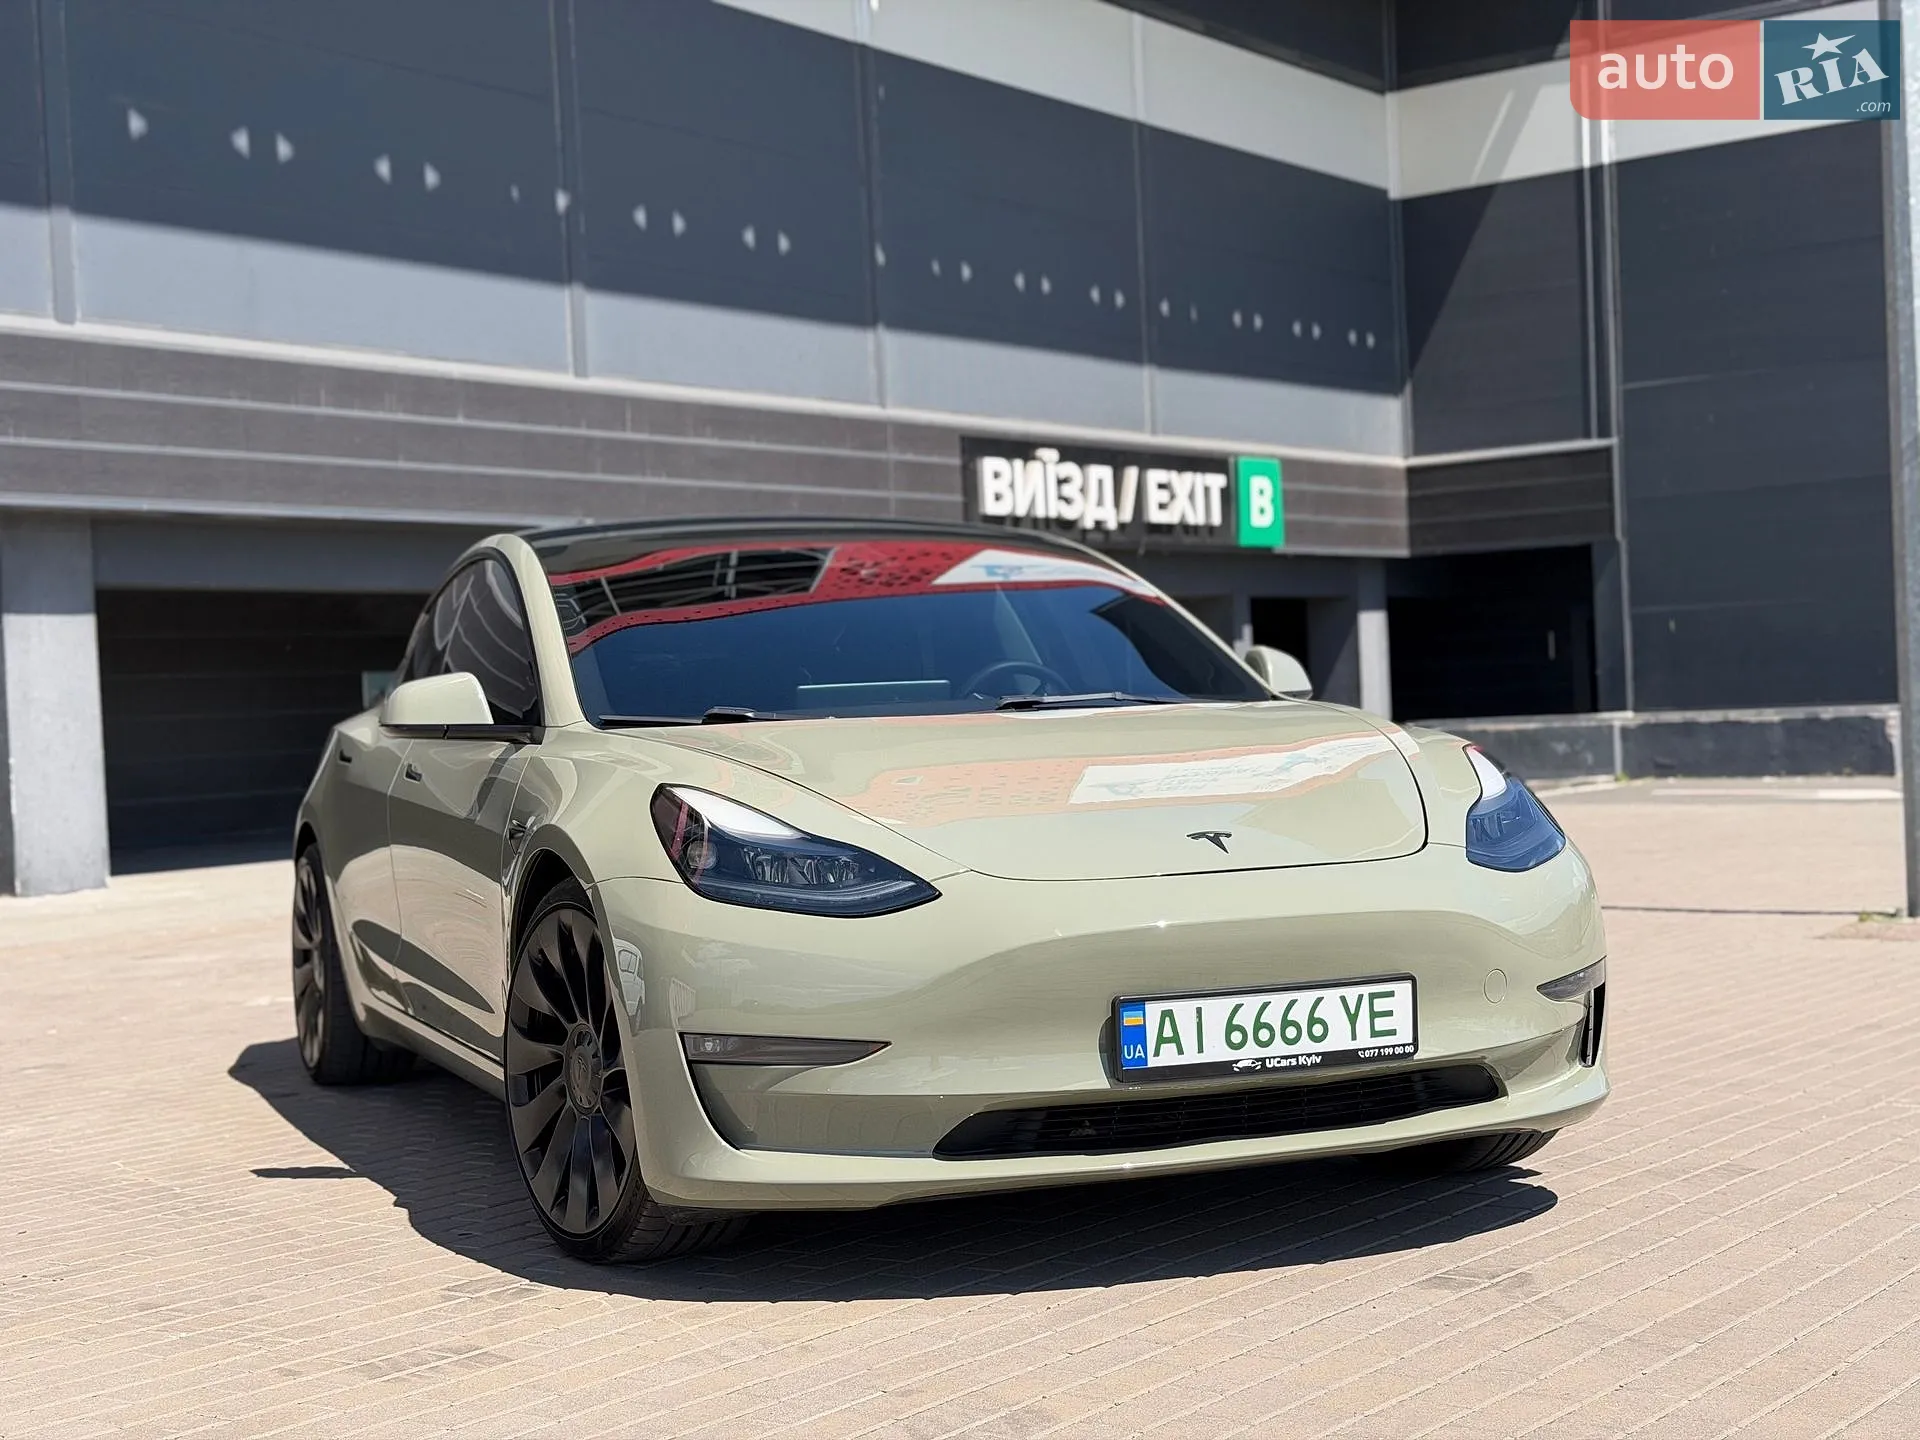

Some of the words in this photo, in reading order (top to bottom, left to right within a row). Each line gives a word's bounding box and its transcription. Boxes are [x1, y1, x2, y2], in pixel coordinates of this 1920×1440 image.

[980, 448, 1117, 529] ВИЇЗД
[1143, 468, 1228, 527] EXIT
[1225, 997, 1328, 1050] 6666
[1339, 990, 1397, 1041] YE
[1124, 1045, 1146, 1060] UA
[1365, 1049, 1379, 1058] 077
[1380, 1047, 1393, 1056] 199
[1404, 1045, 1414, 1053] 00
[1265, 1056, 1297, 1068] UCars
[1298, 1055, 1322, 1067] Kyiv
